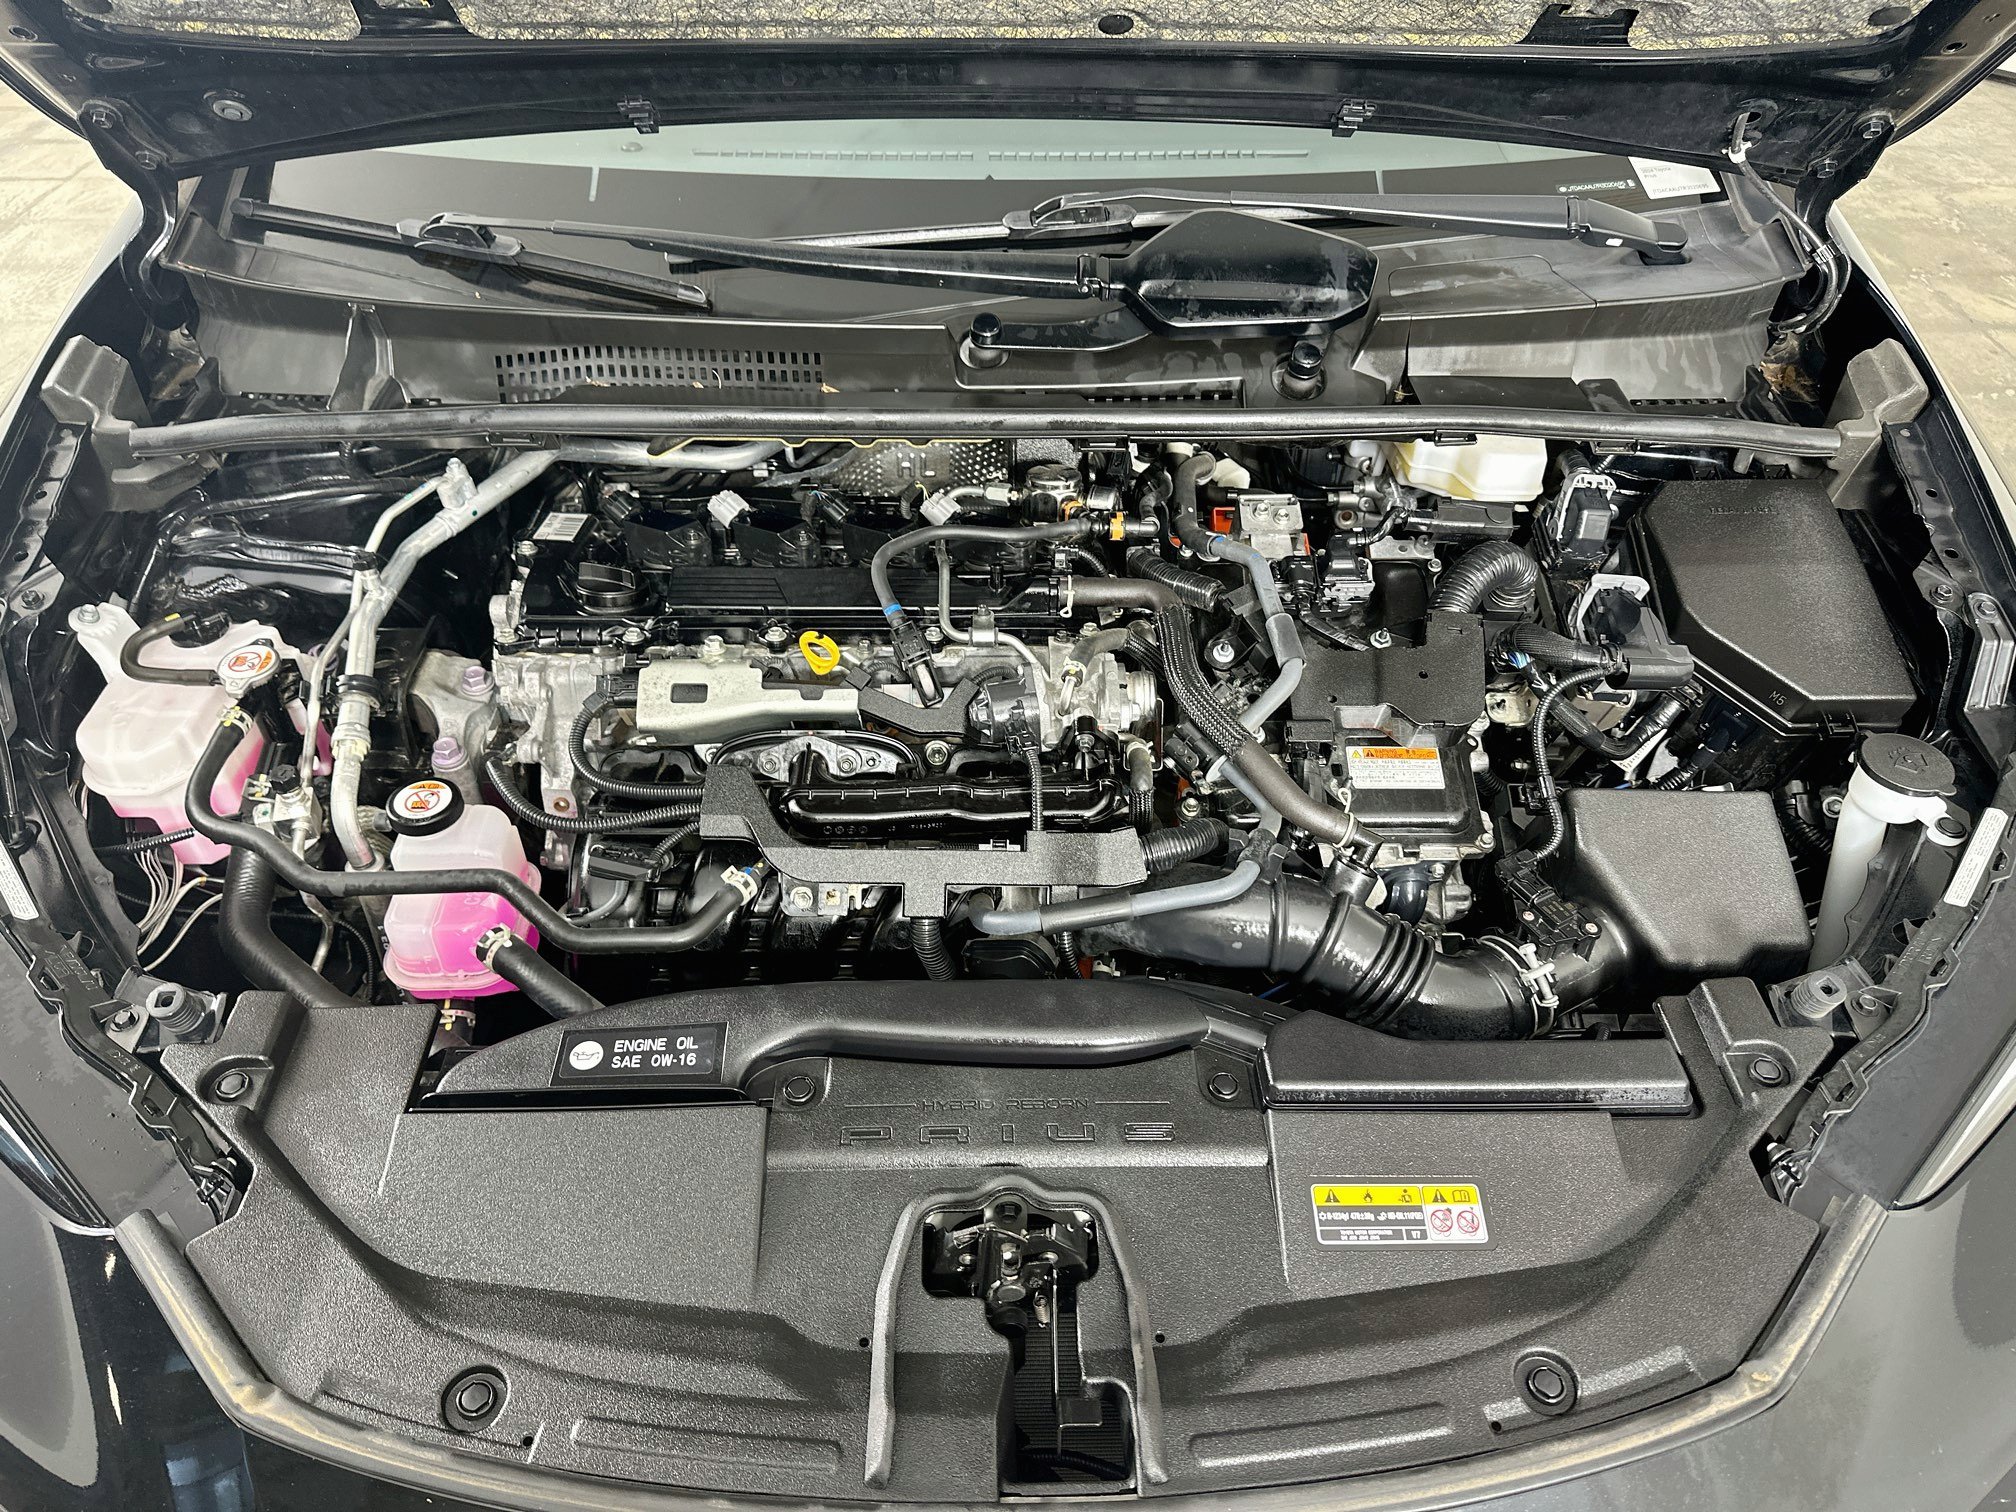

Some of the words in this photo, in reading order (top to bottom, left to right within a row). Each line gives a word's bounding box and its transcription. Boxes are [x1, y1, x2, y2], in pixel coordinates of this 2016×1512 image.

[1768, 690, 1787, 705] M5
[613, 1037, 668, 1053] ENGINE
[676, 1036, 699, 1050] OIL
[611, 1054, 642, 1069] SAE
[650, 1052, 697, 1067] 0W-16
[922, 1099, 995, 1112] HYBRID
[1005, 1098, 1089, 1110] REBORN
[840, 1122, 1175, 1146] PRIUS
